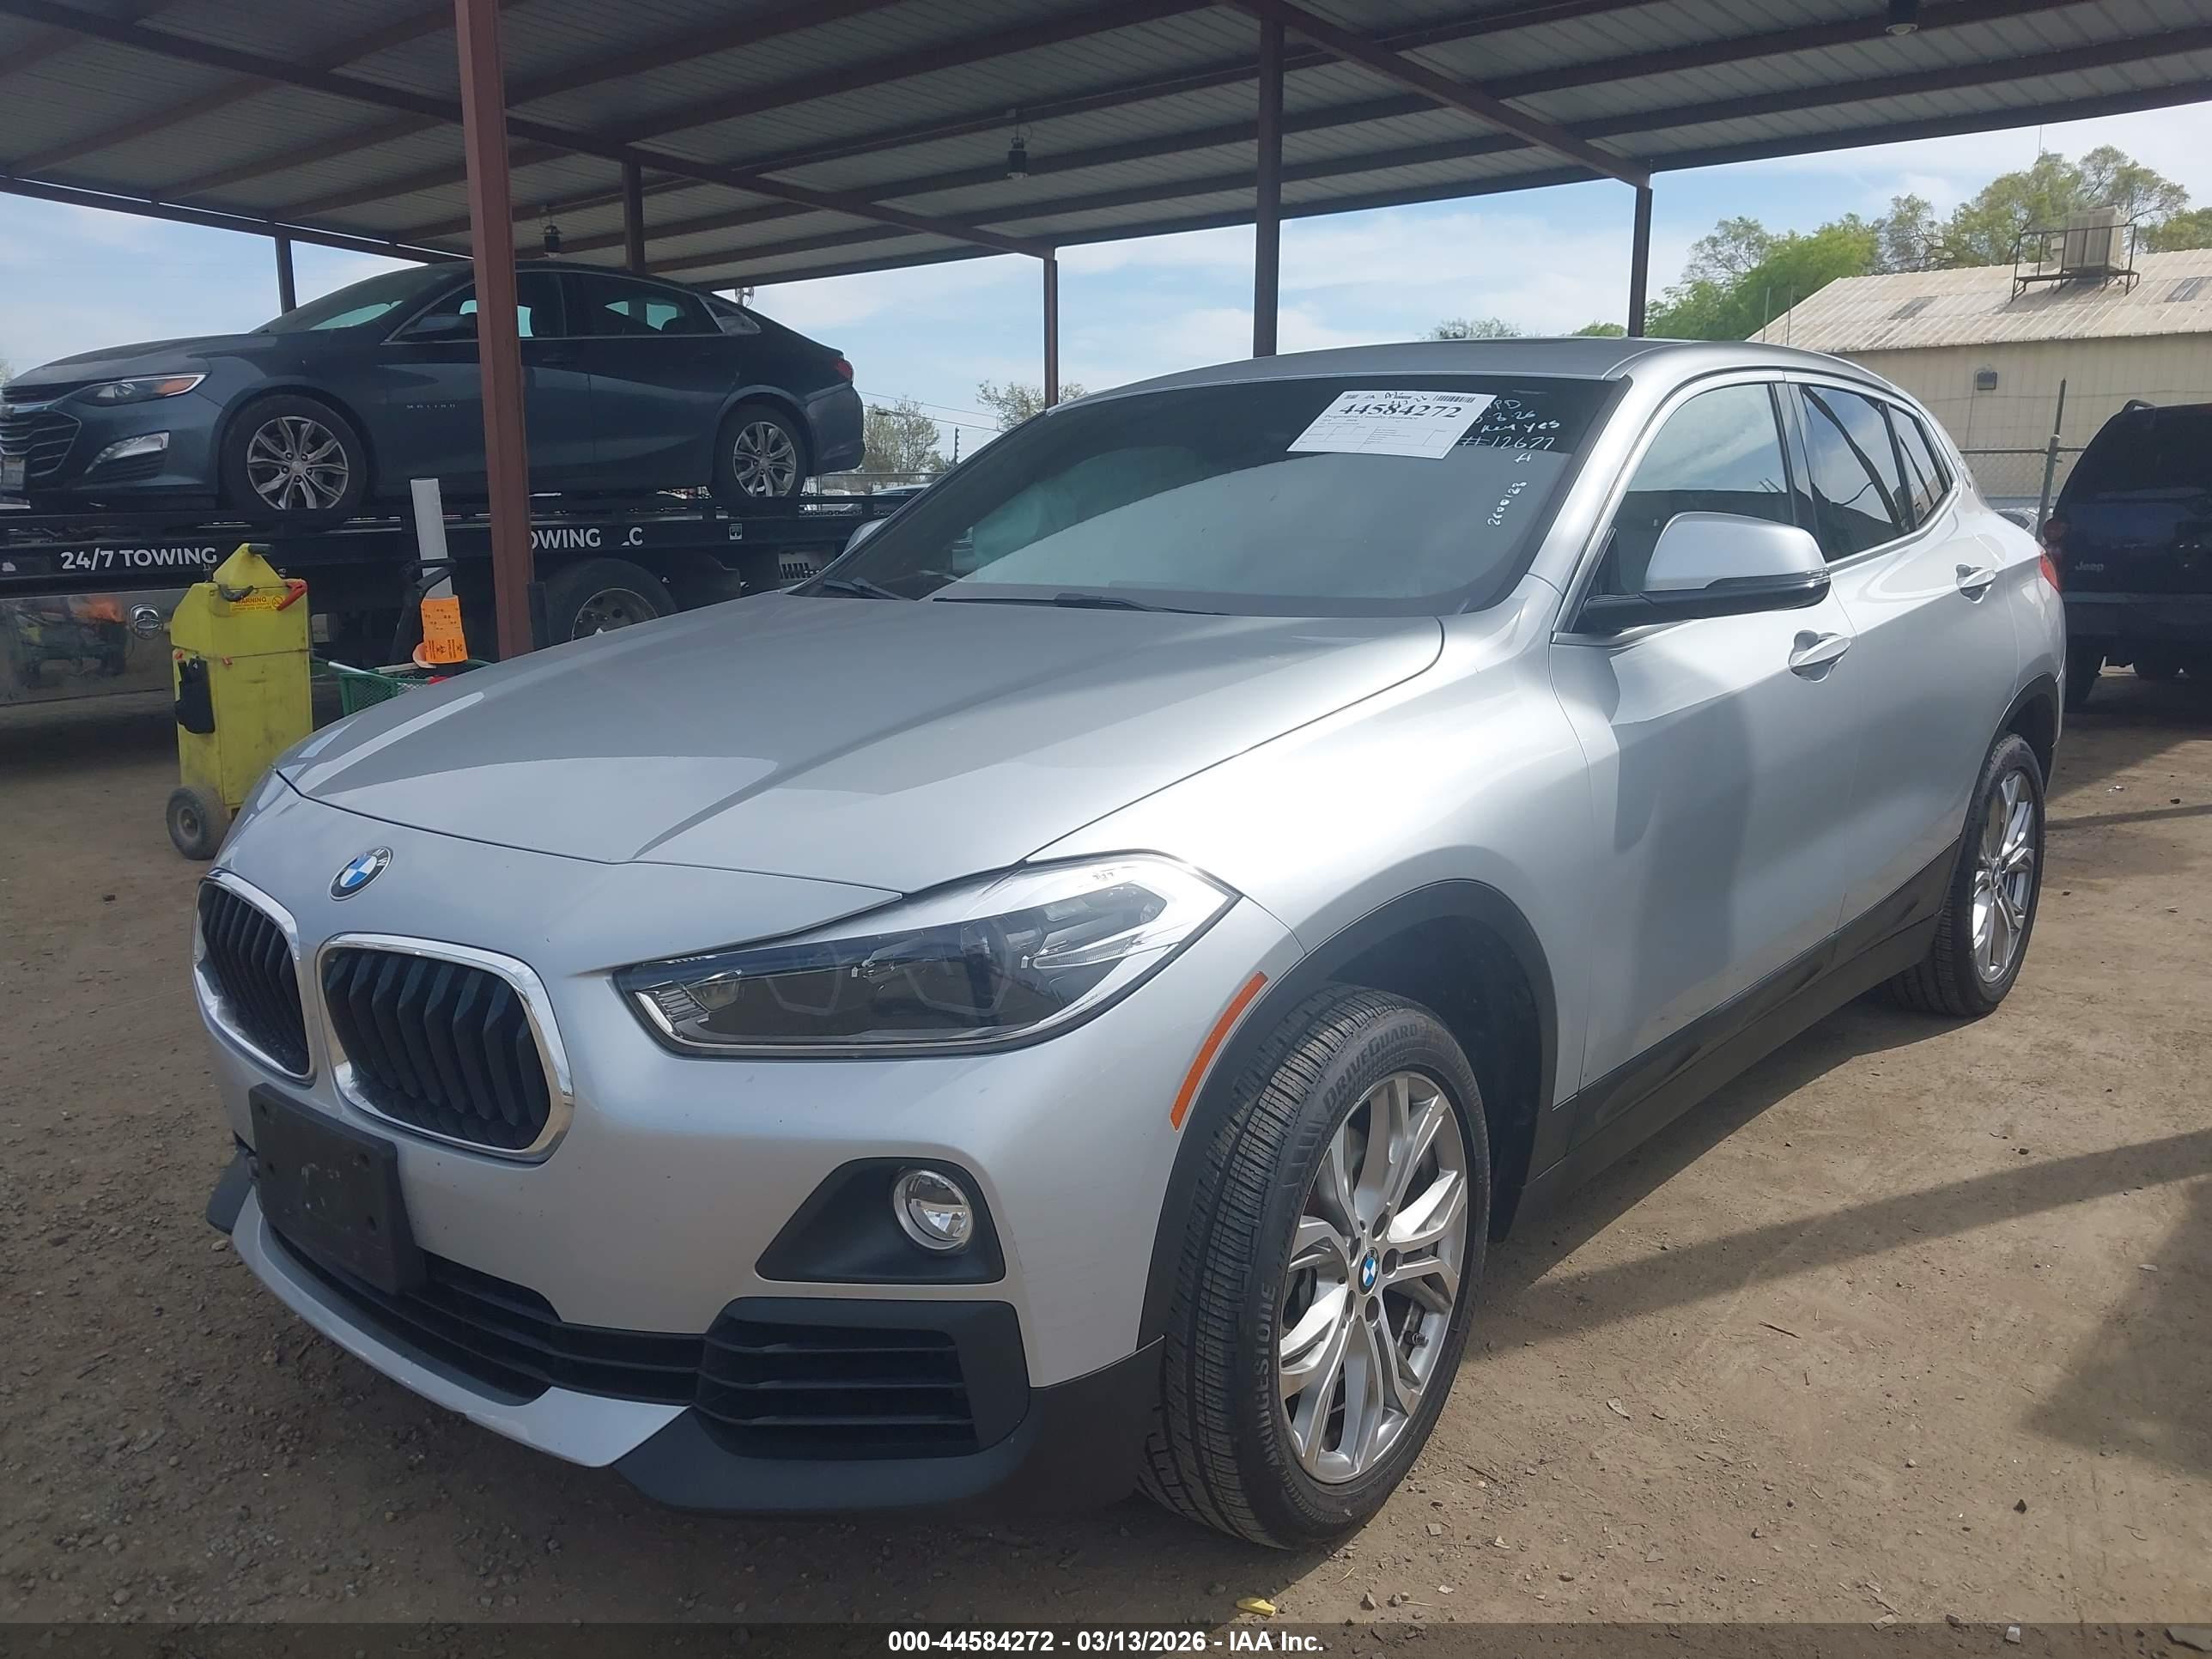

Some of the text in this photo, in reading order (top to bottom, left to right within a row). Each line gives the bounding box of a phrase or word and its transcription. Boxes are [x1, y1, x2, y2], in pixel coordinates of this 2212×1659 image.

[1339, 403, 1462, 418] 44584272
[60, 547, 217, 571] 24/7 TOWING
[2075, 561, 2105, 573] Jeep
